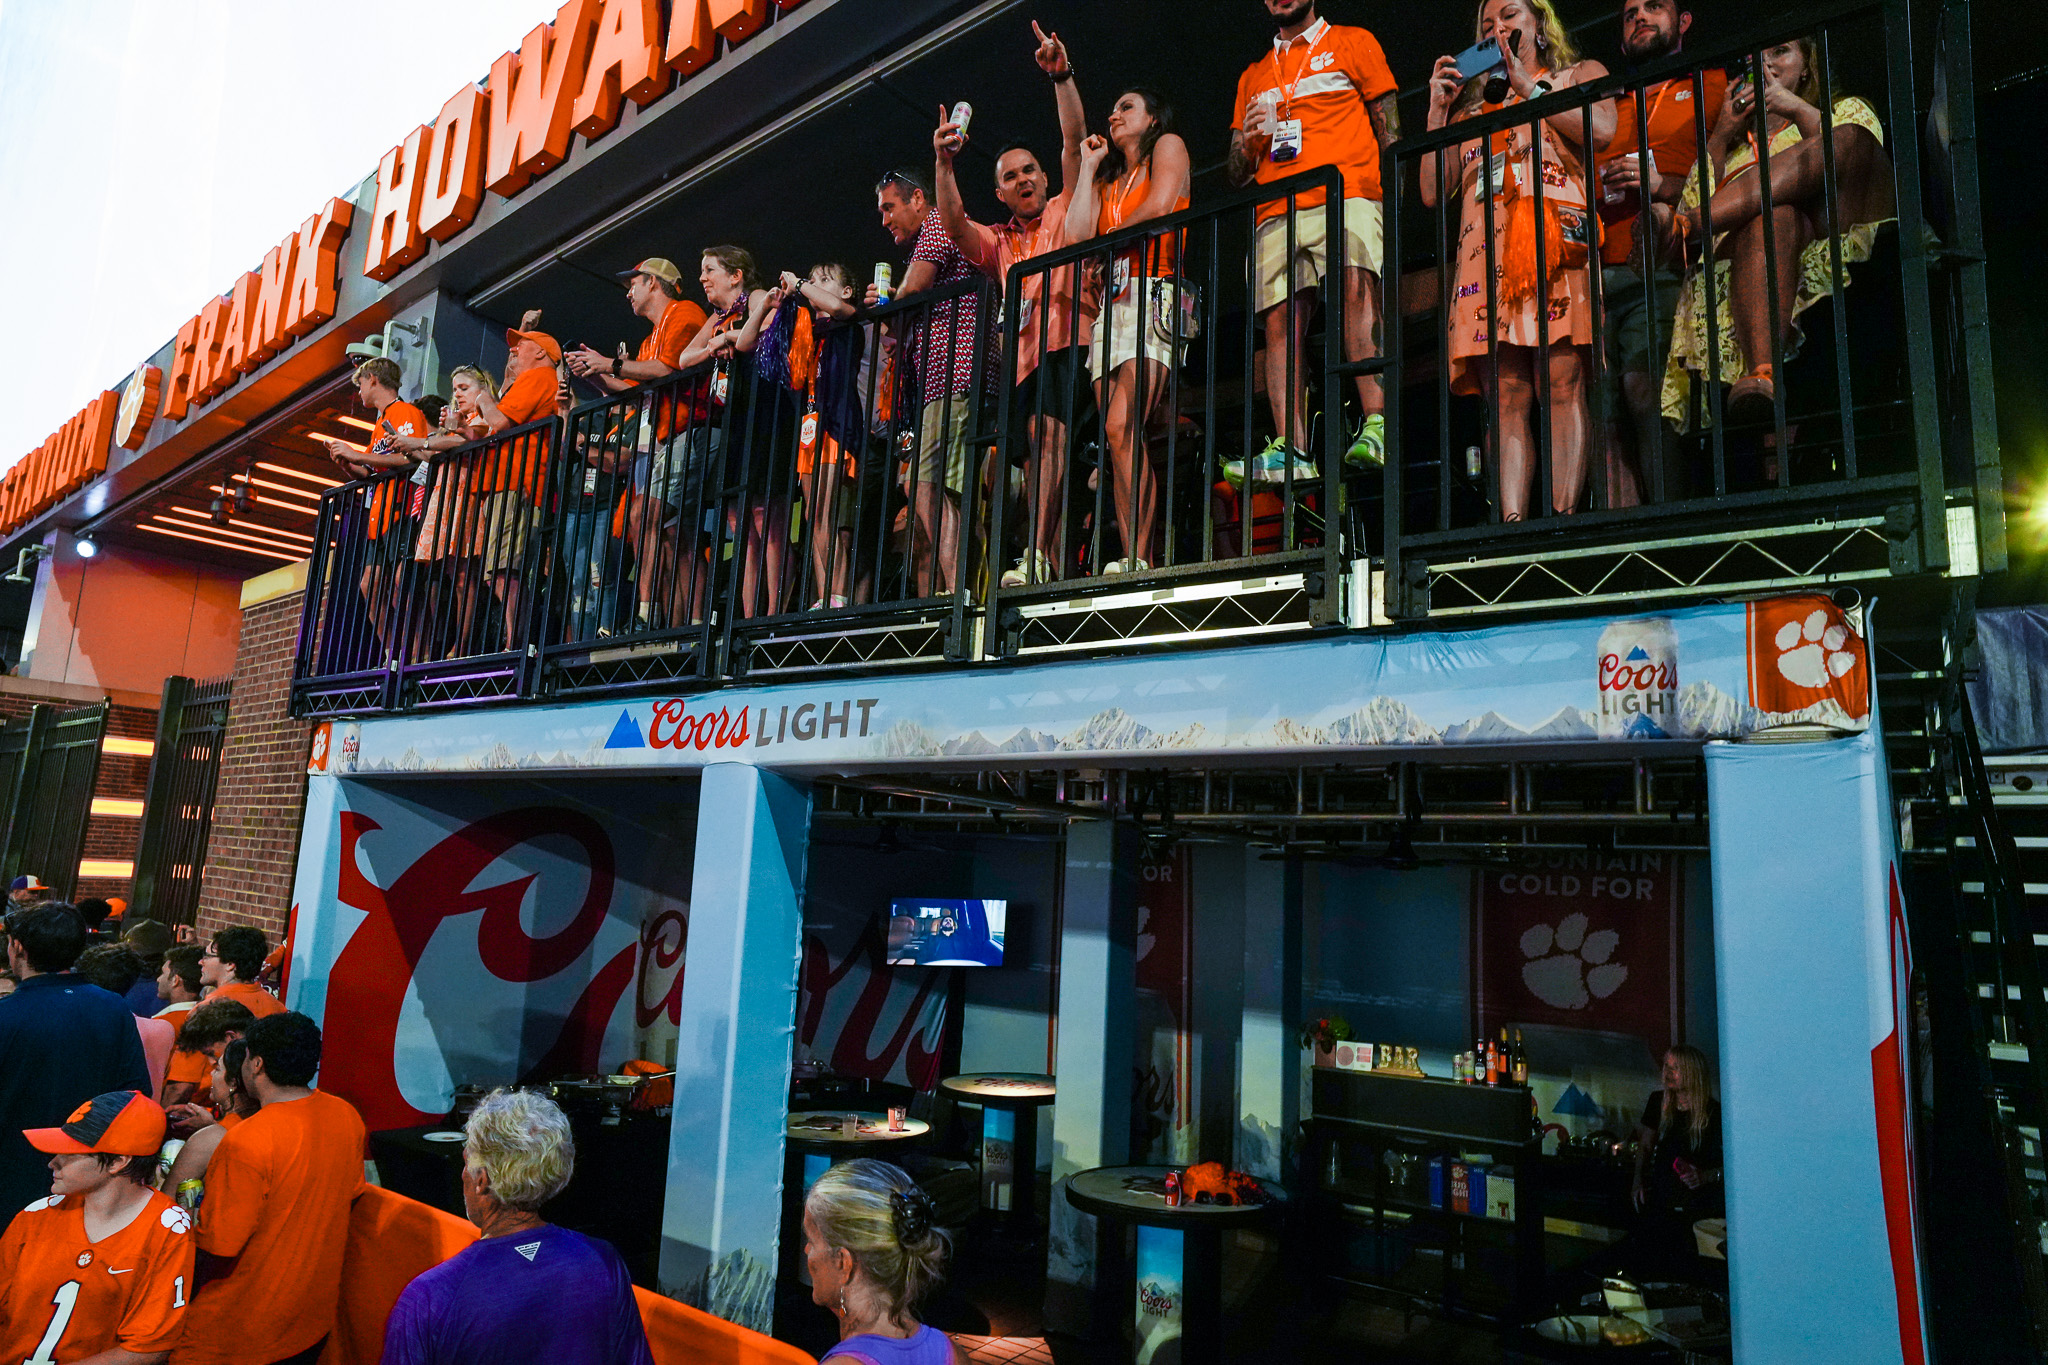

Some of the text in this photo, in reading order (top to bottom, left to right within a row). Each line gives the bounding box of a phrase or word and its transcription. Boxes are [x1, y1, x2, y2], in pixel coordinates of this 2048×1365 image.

[163, 196, 353, 421] FRANK
[363, 0, 800, 282] HOWA
[1598, 653, 1678, 692] Coors
[1601, 693, 1676, 715] LIGHT
[649, 698, 879, 751] Coors LIGHT
[1141, 864, 1173, 883] OR
[1499, 872, 1654, 901] COLD FOR
[173, 1275, 186, 1309] 1
[1140, 1288, 1173, 1310] Coors
[22, 1279, 82, 1365] 1
[1142, 1303, 1169, 1318] LIGHT
